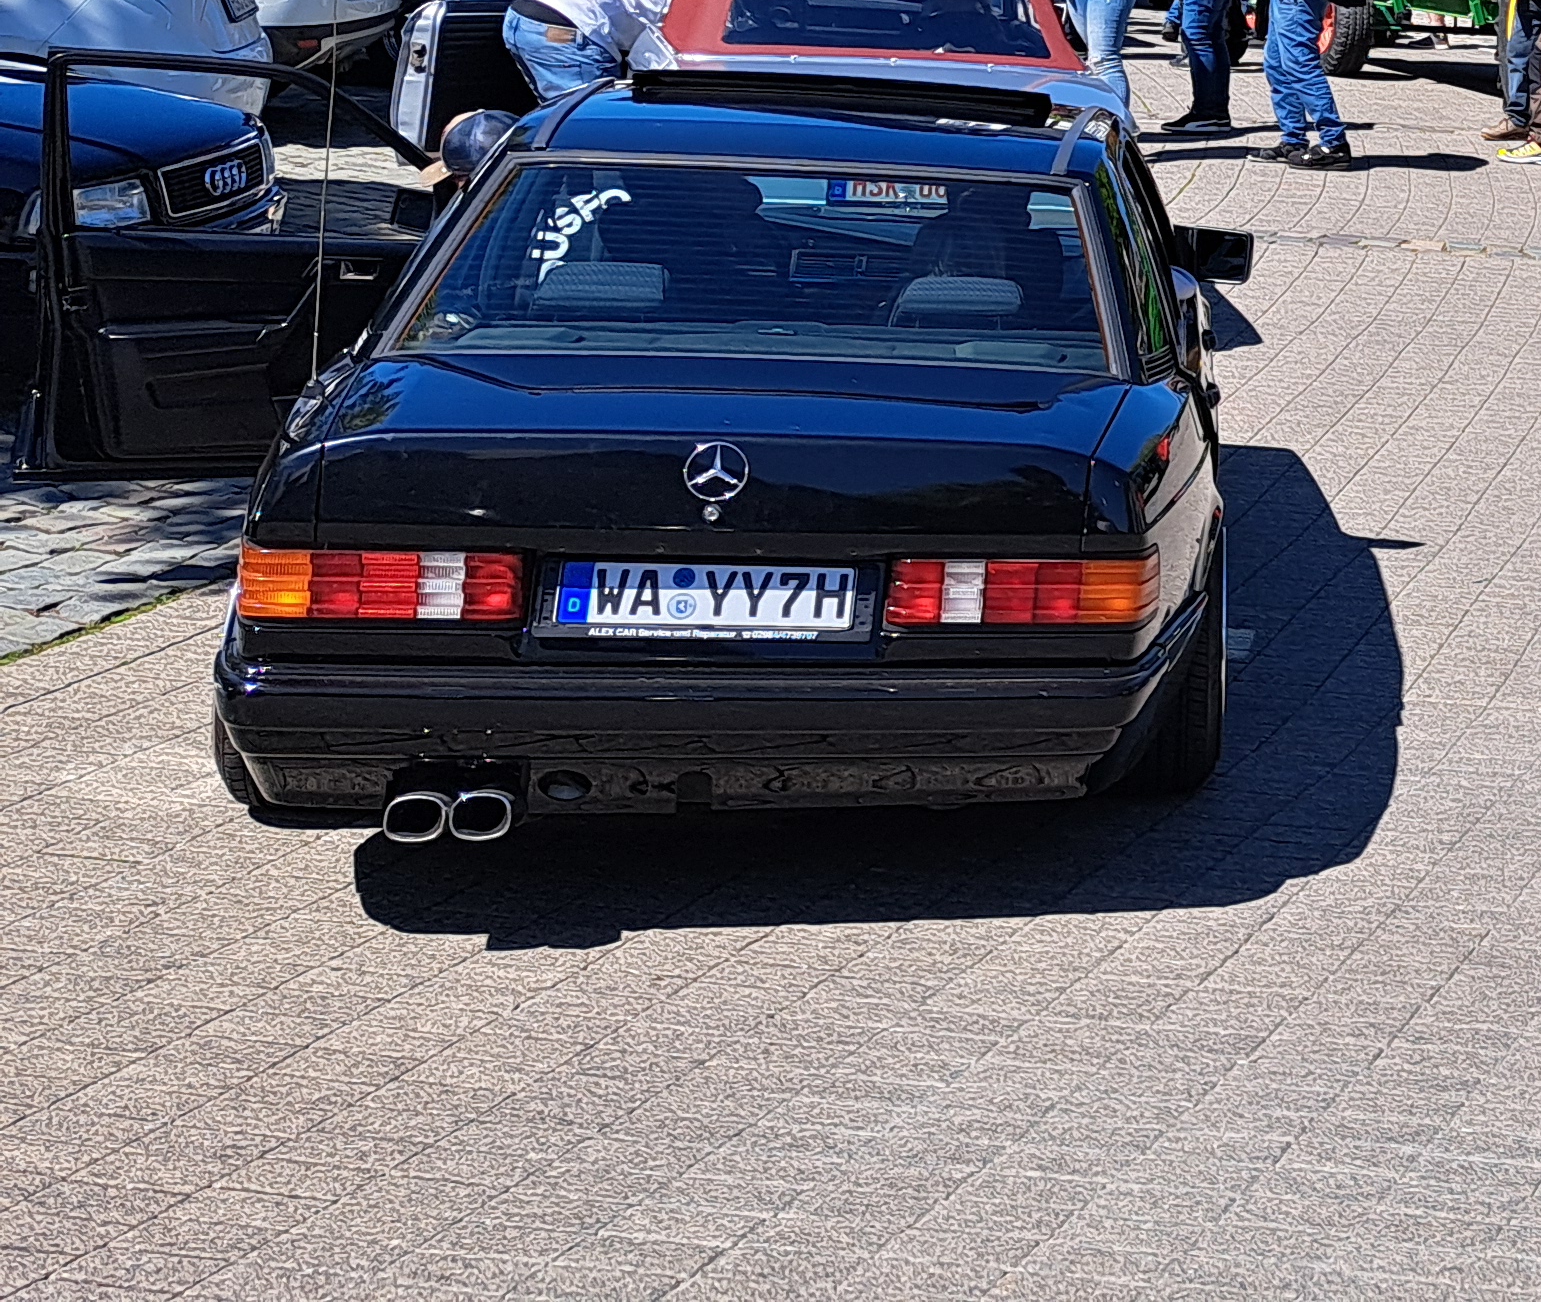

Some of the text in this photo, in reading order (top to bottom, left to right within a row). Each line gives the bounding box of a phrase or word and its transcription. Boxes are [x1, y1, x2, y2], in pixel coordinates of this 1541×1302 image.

[596, 568, 849, 619] WA YY7H
[588, 627, 613, 636] ALEX
[615, 628, 637, 637] CAR
[638, 628, 672, 638] Service
